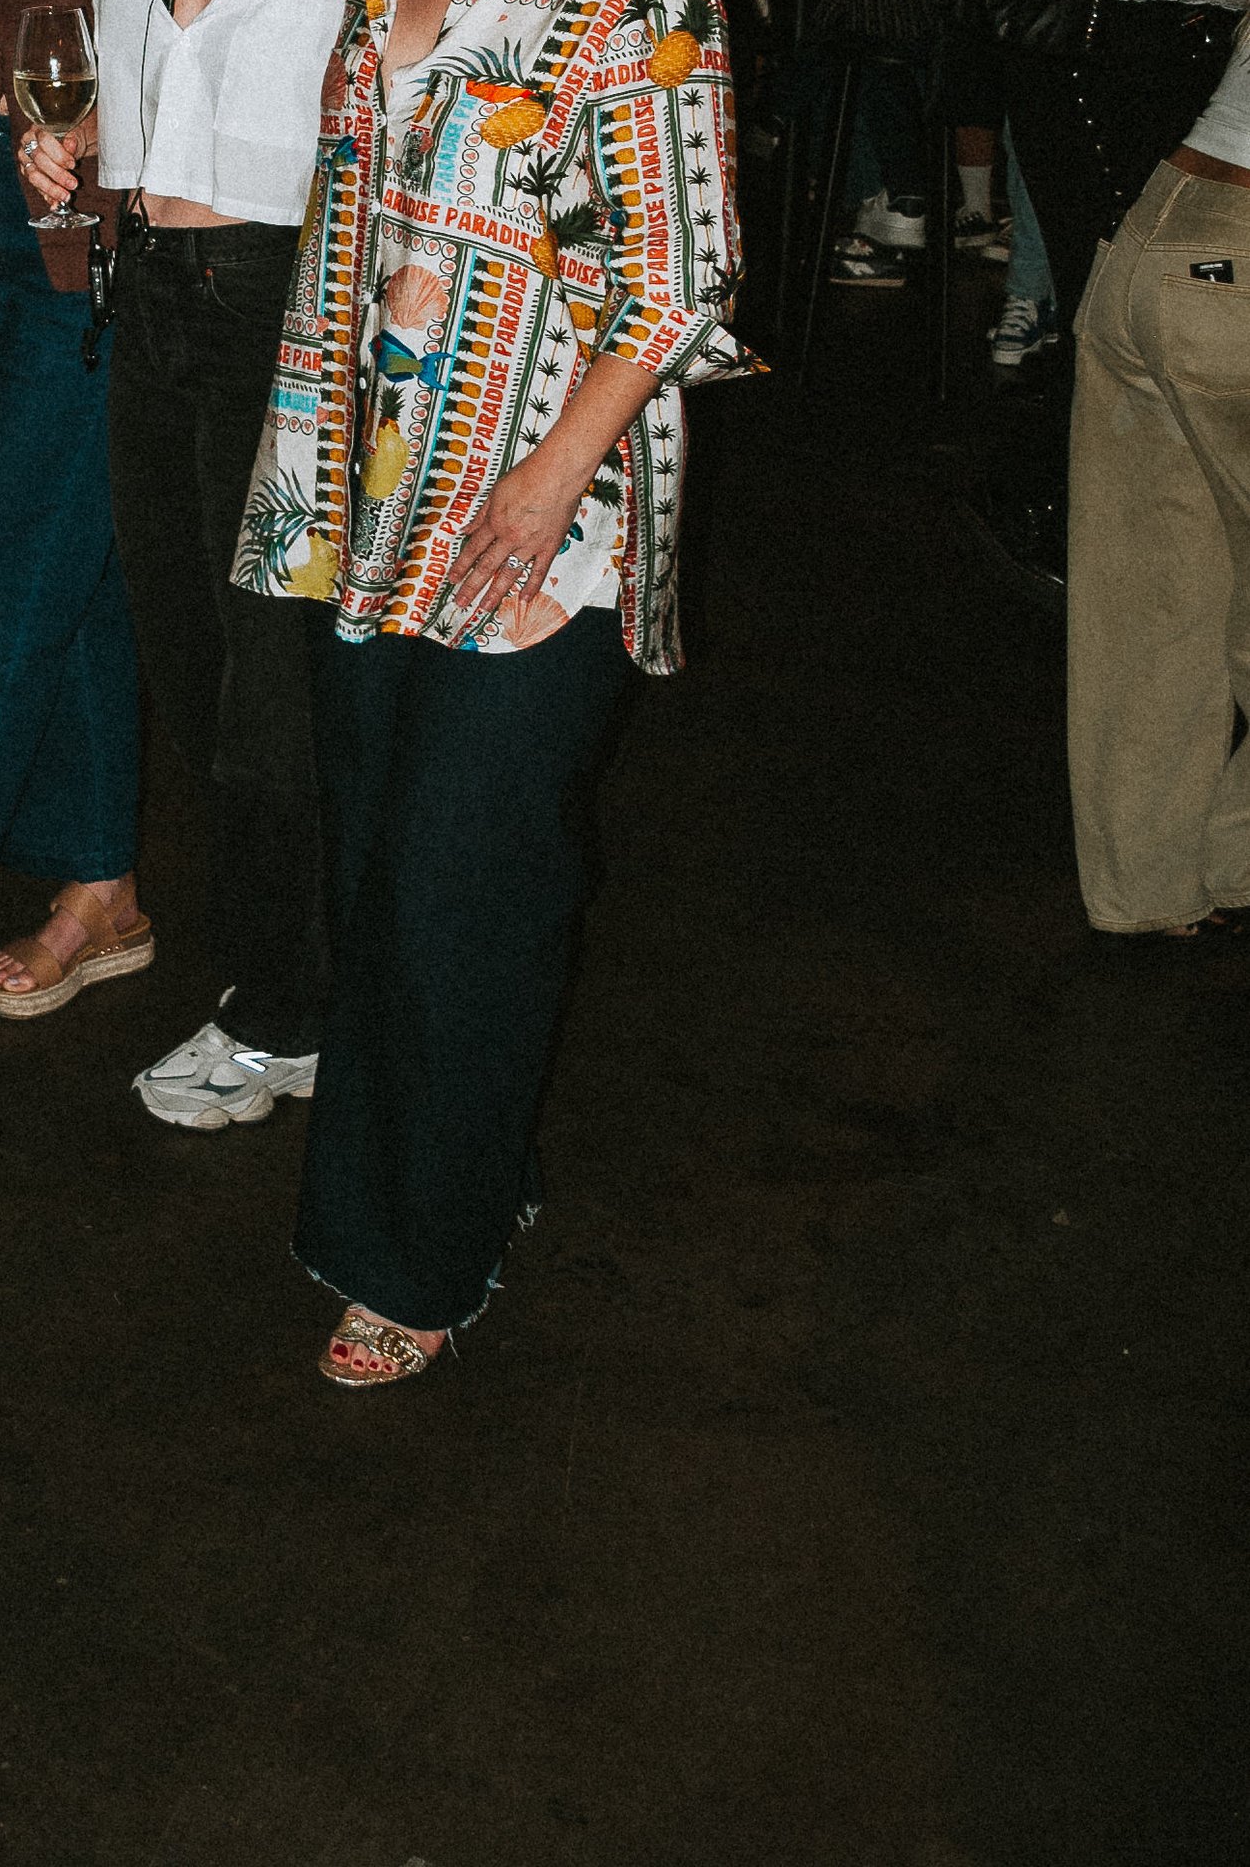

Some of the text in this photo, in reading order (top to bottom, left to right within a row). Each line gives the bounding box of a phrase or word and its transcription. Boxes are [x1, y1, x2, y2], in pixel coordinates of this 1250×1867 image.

[537, 63, 590, 152] ARADISE
[634, 95, 664, 195] PARADISE
[645, 199, 670, 285] PARADISE
[494, 262, 529, 358] PARADISE
[472, 359, 511, 453] PARADISE
[440, 454, 489, 536] PARADISE
[409, 536, 451, 625] PARADISE
